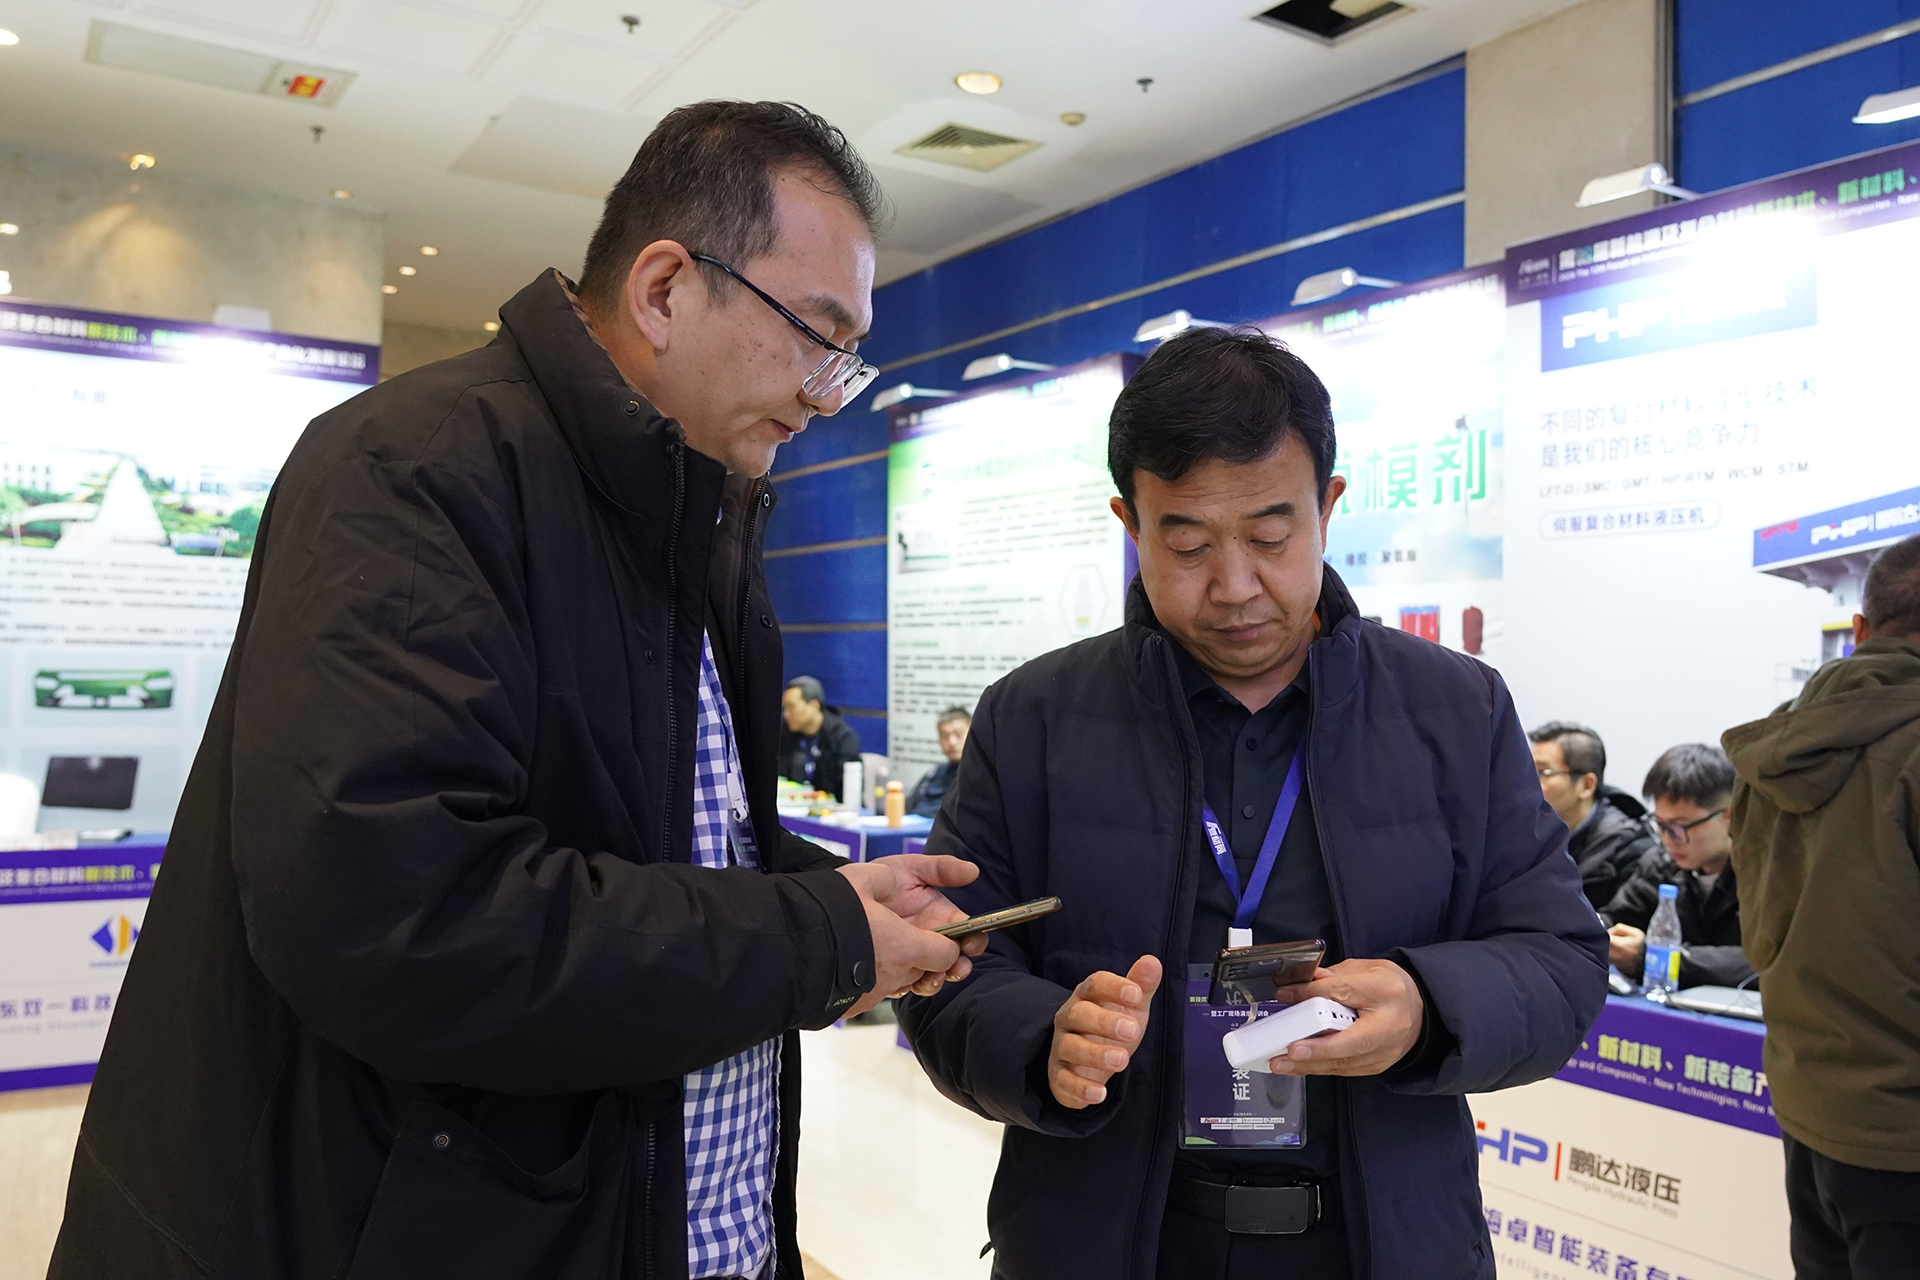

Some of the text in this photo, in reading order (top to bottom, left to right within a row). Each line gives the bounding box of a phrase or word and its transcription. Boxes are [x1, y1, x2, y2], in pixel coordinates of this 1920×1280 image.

[1210, 1010, 1269, 1018] 暨工厂现场演训会
[1653, 1076, 1675, 1092] New
[1567, 1146, 1683, 1205] 鹏达液压
